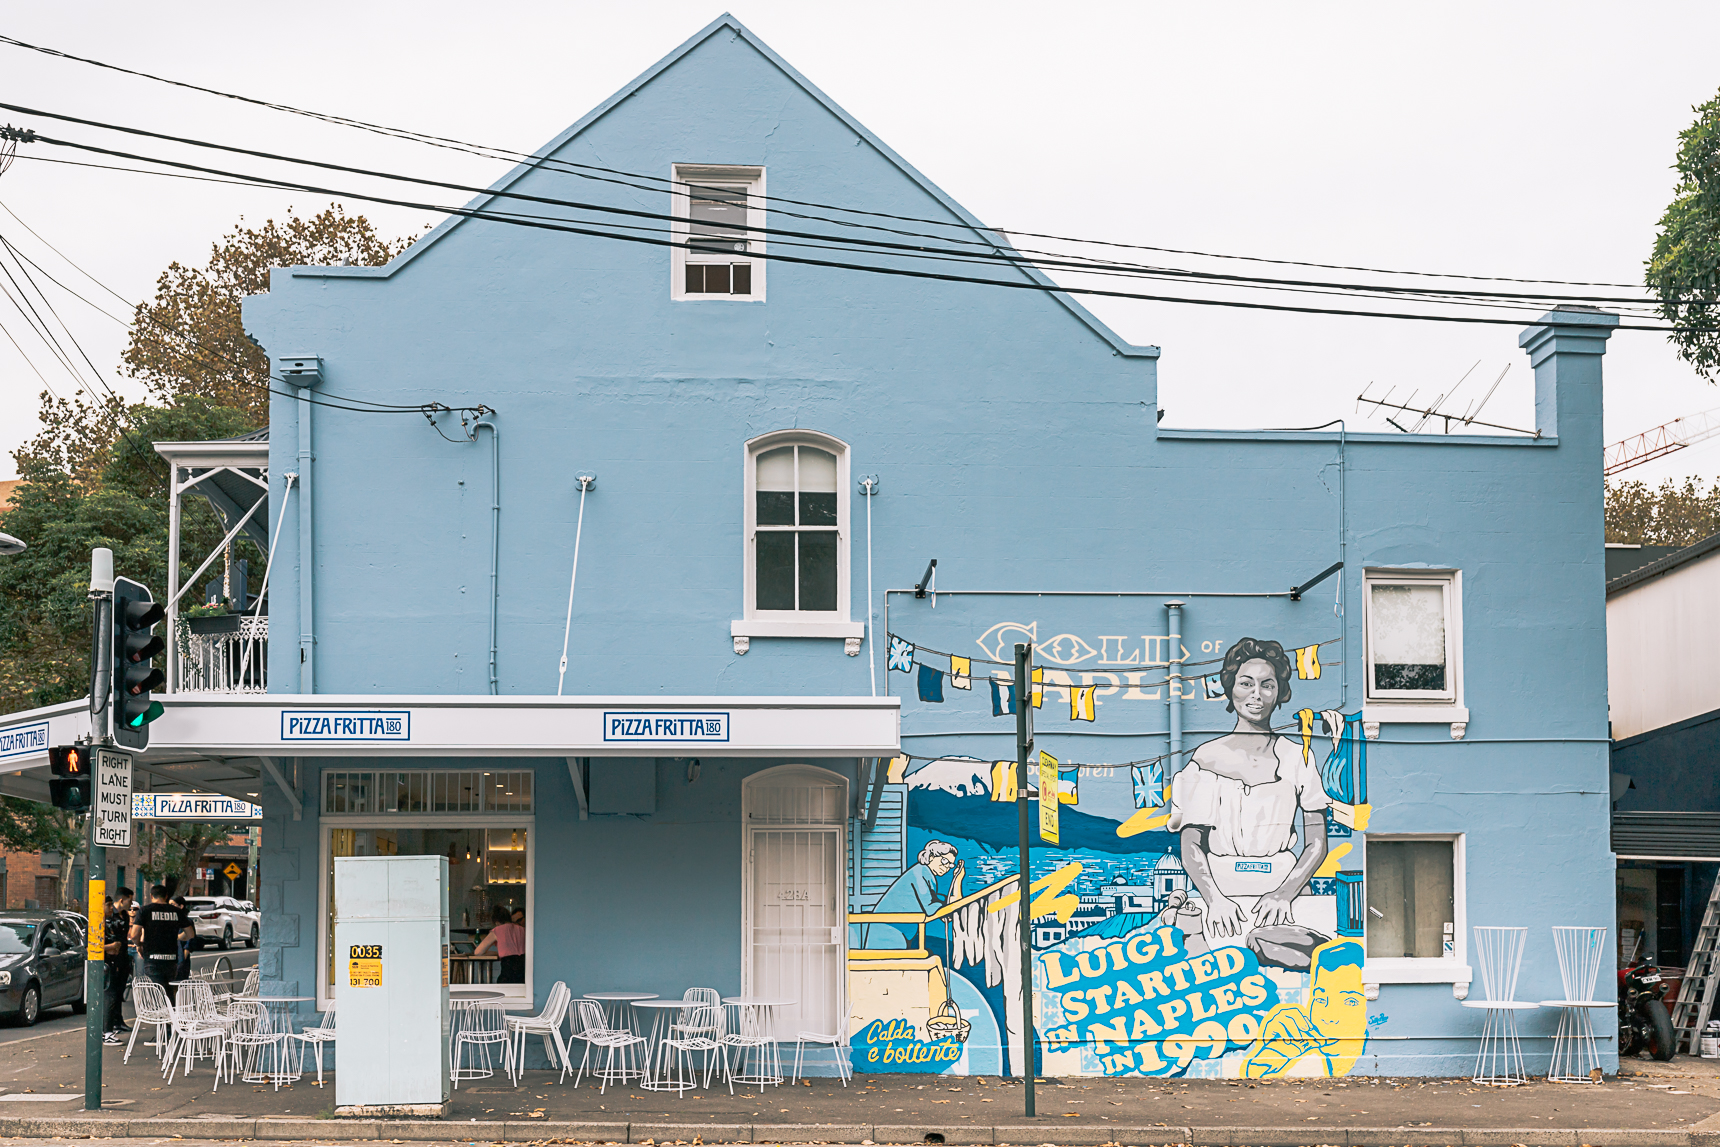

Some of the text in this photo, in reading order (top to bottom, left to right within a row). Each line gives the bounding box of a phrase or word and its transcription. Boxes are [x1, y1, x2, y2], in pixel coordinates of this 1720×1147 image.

[1201, 640, 1223, 653] OF
[385, 719, 402, 733] 180
[705, 720, 721, 734] 180
[102, 755, 129, 770] RIGHT
[101, 773, 128, 788] LANE
[101, 791, 128, 806] MUST
[234, 801, 246, 812] 180
[101, 810, 127, 824] TURN
[100, 827, 127, 843] RIGHT
[151, 911, 179, 921] MEDIA
[351, 946, 380, 958] 0035
[1040, 927, 1178, 989] LUIGI
[1061, 946, 1245, 1022] STARTED
[1046, 974, 1268, 1055] IN NAPLES
[867, 1020, 914, 1044] Calda
[868, 1038, 960, 1064] e bollente
[1101, 1013, 1259, 1075] IN 1990
